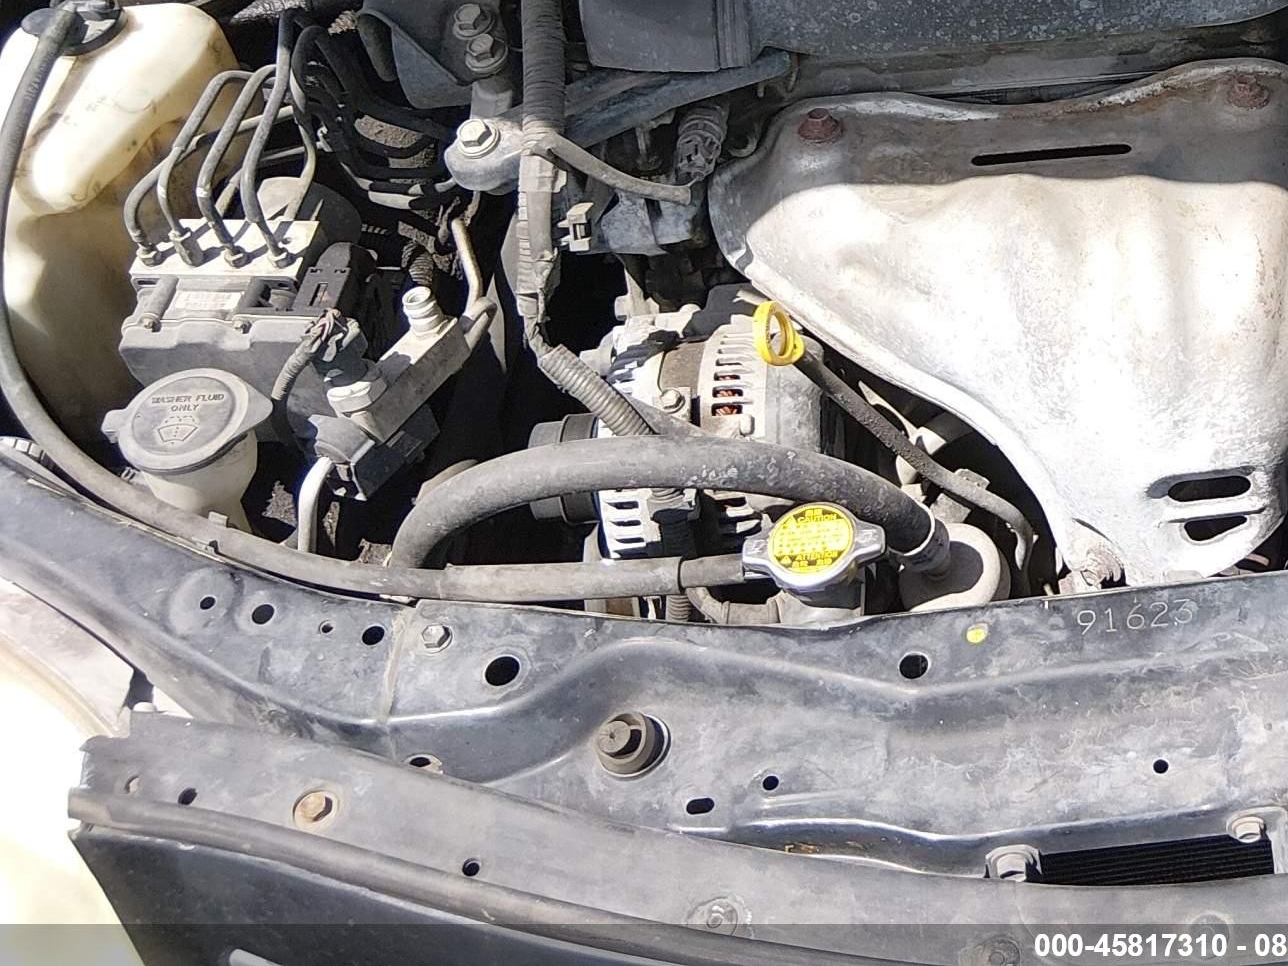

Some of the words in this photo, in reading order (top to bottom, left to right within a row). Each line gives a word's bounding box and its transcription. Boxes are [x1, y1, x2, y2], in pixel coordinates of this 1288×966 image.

[195, 393, 225, 402] FLUID
[170, 404, 199, 412] ONLY
[797, 514, 838, 522] CAUTION
[1076, 598, 1194, 635] 91623
